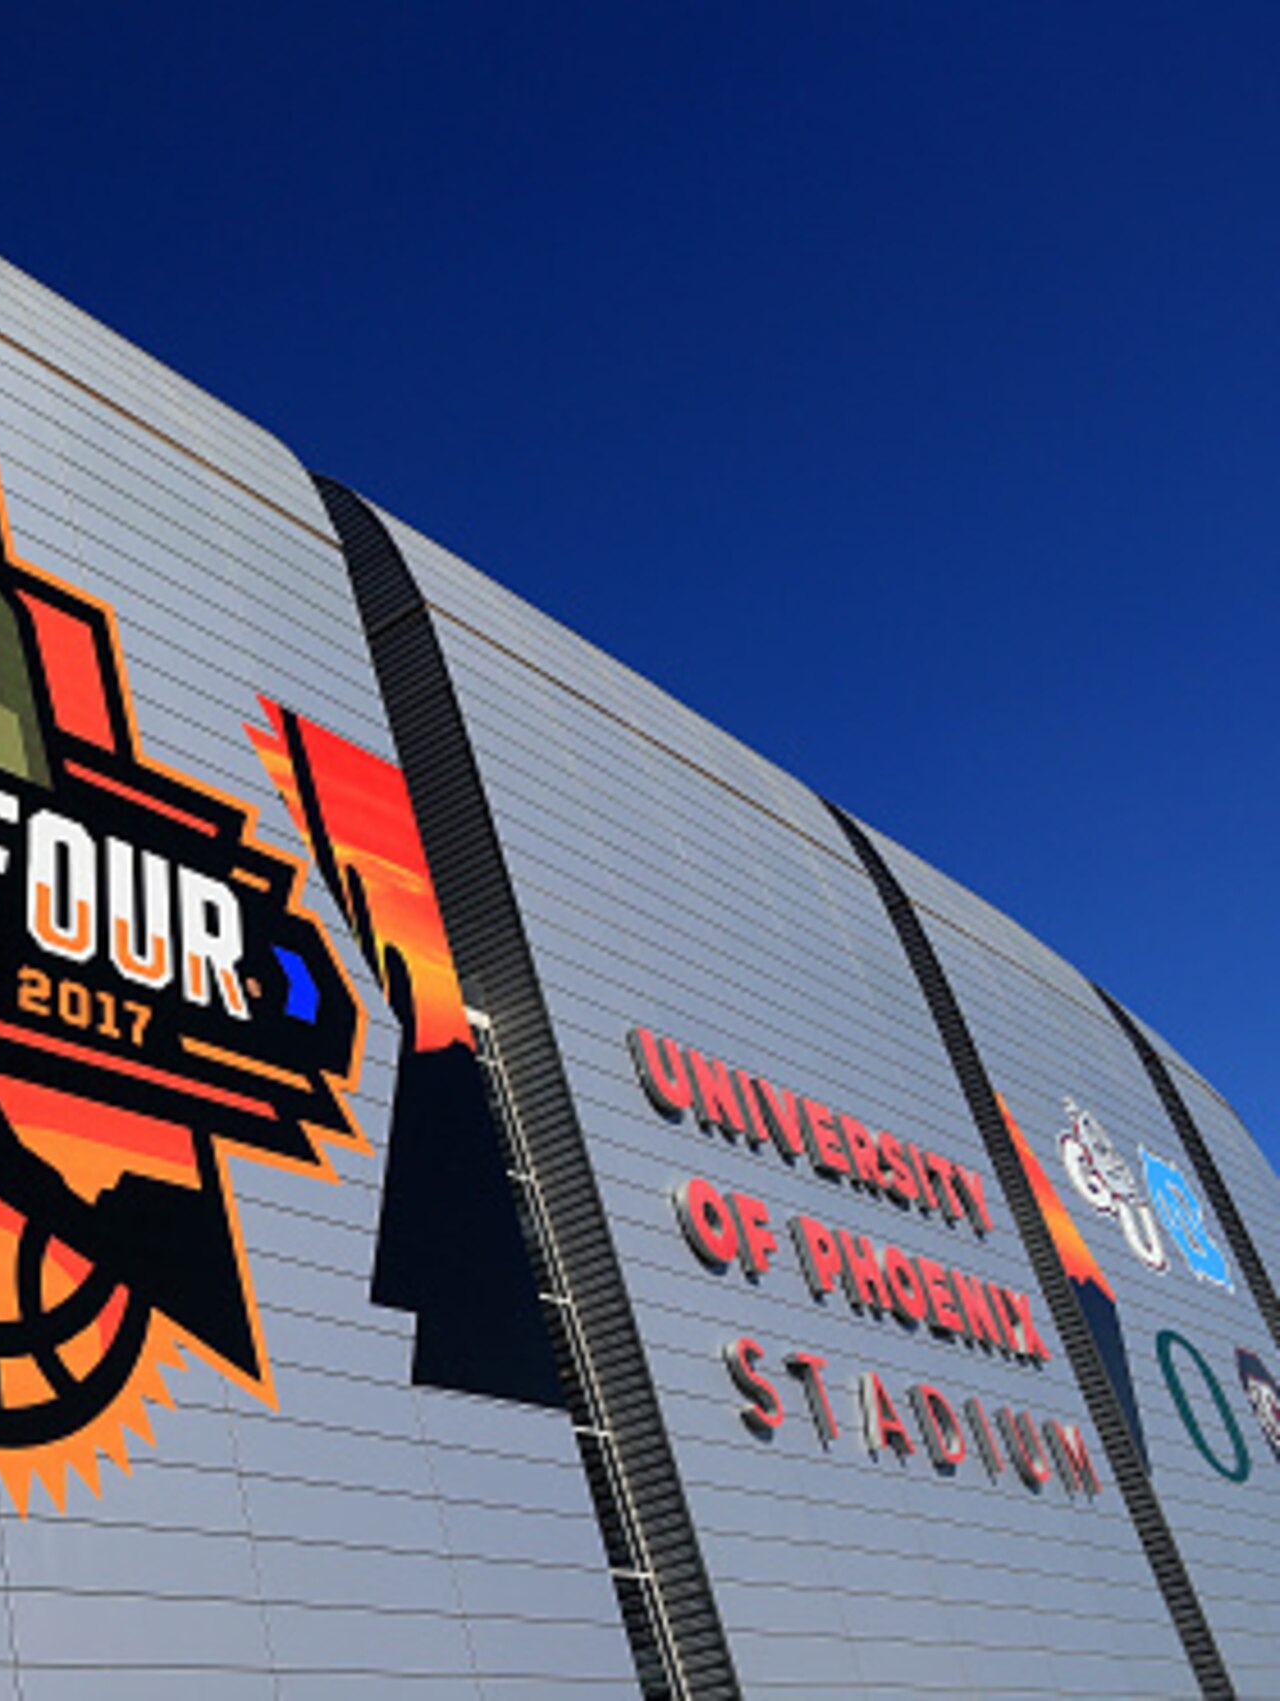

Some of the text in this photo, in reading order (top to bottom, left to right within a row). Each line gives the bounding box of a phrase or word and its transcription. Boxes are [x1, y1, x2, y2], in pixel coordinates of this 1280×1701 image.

[17, 966, 154, 1046] 2017
[628, 1027, 994, 1240] UNIVERSITY
[674, 1177, 778, 1280] OF
[788, 1215, 1050, 1366] PHOENIX
[722, 1337, 1103, 1499] STADIUM
